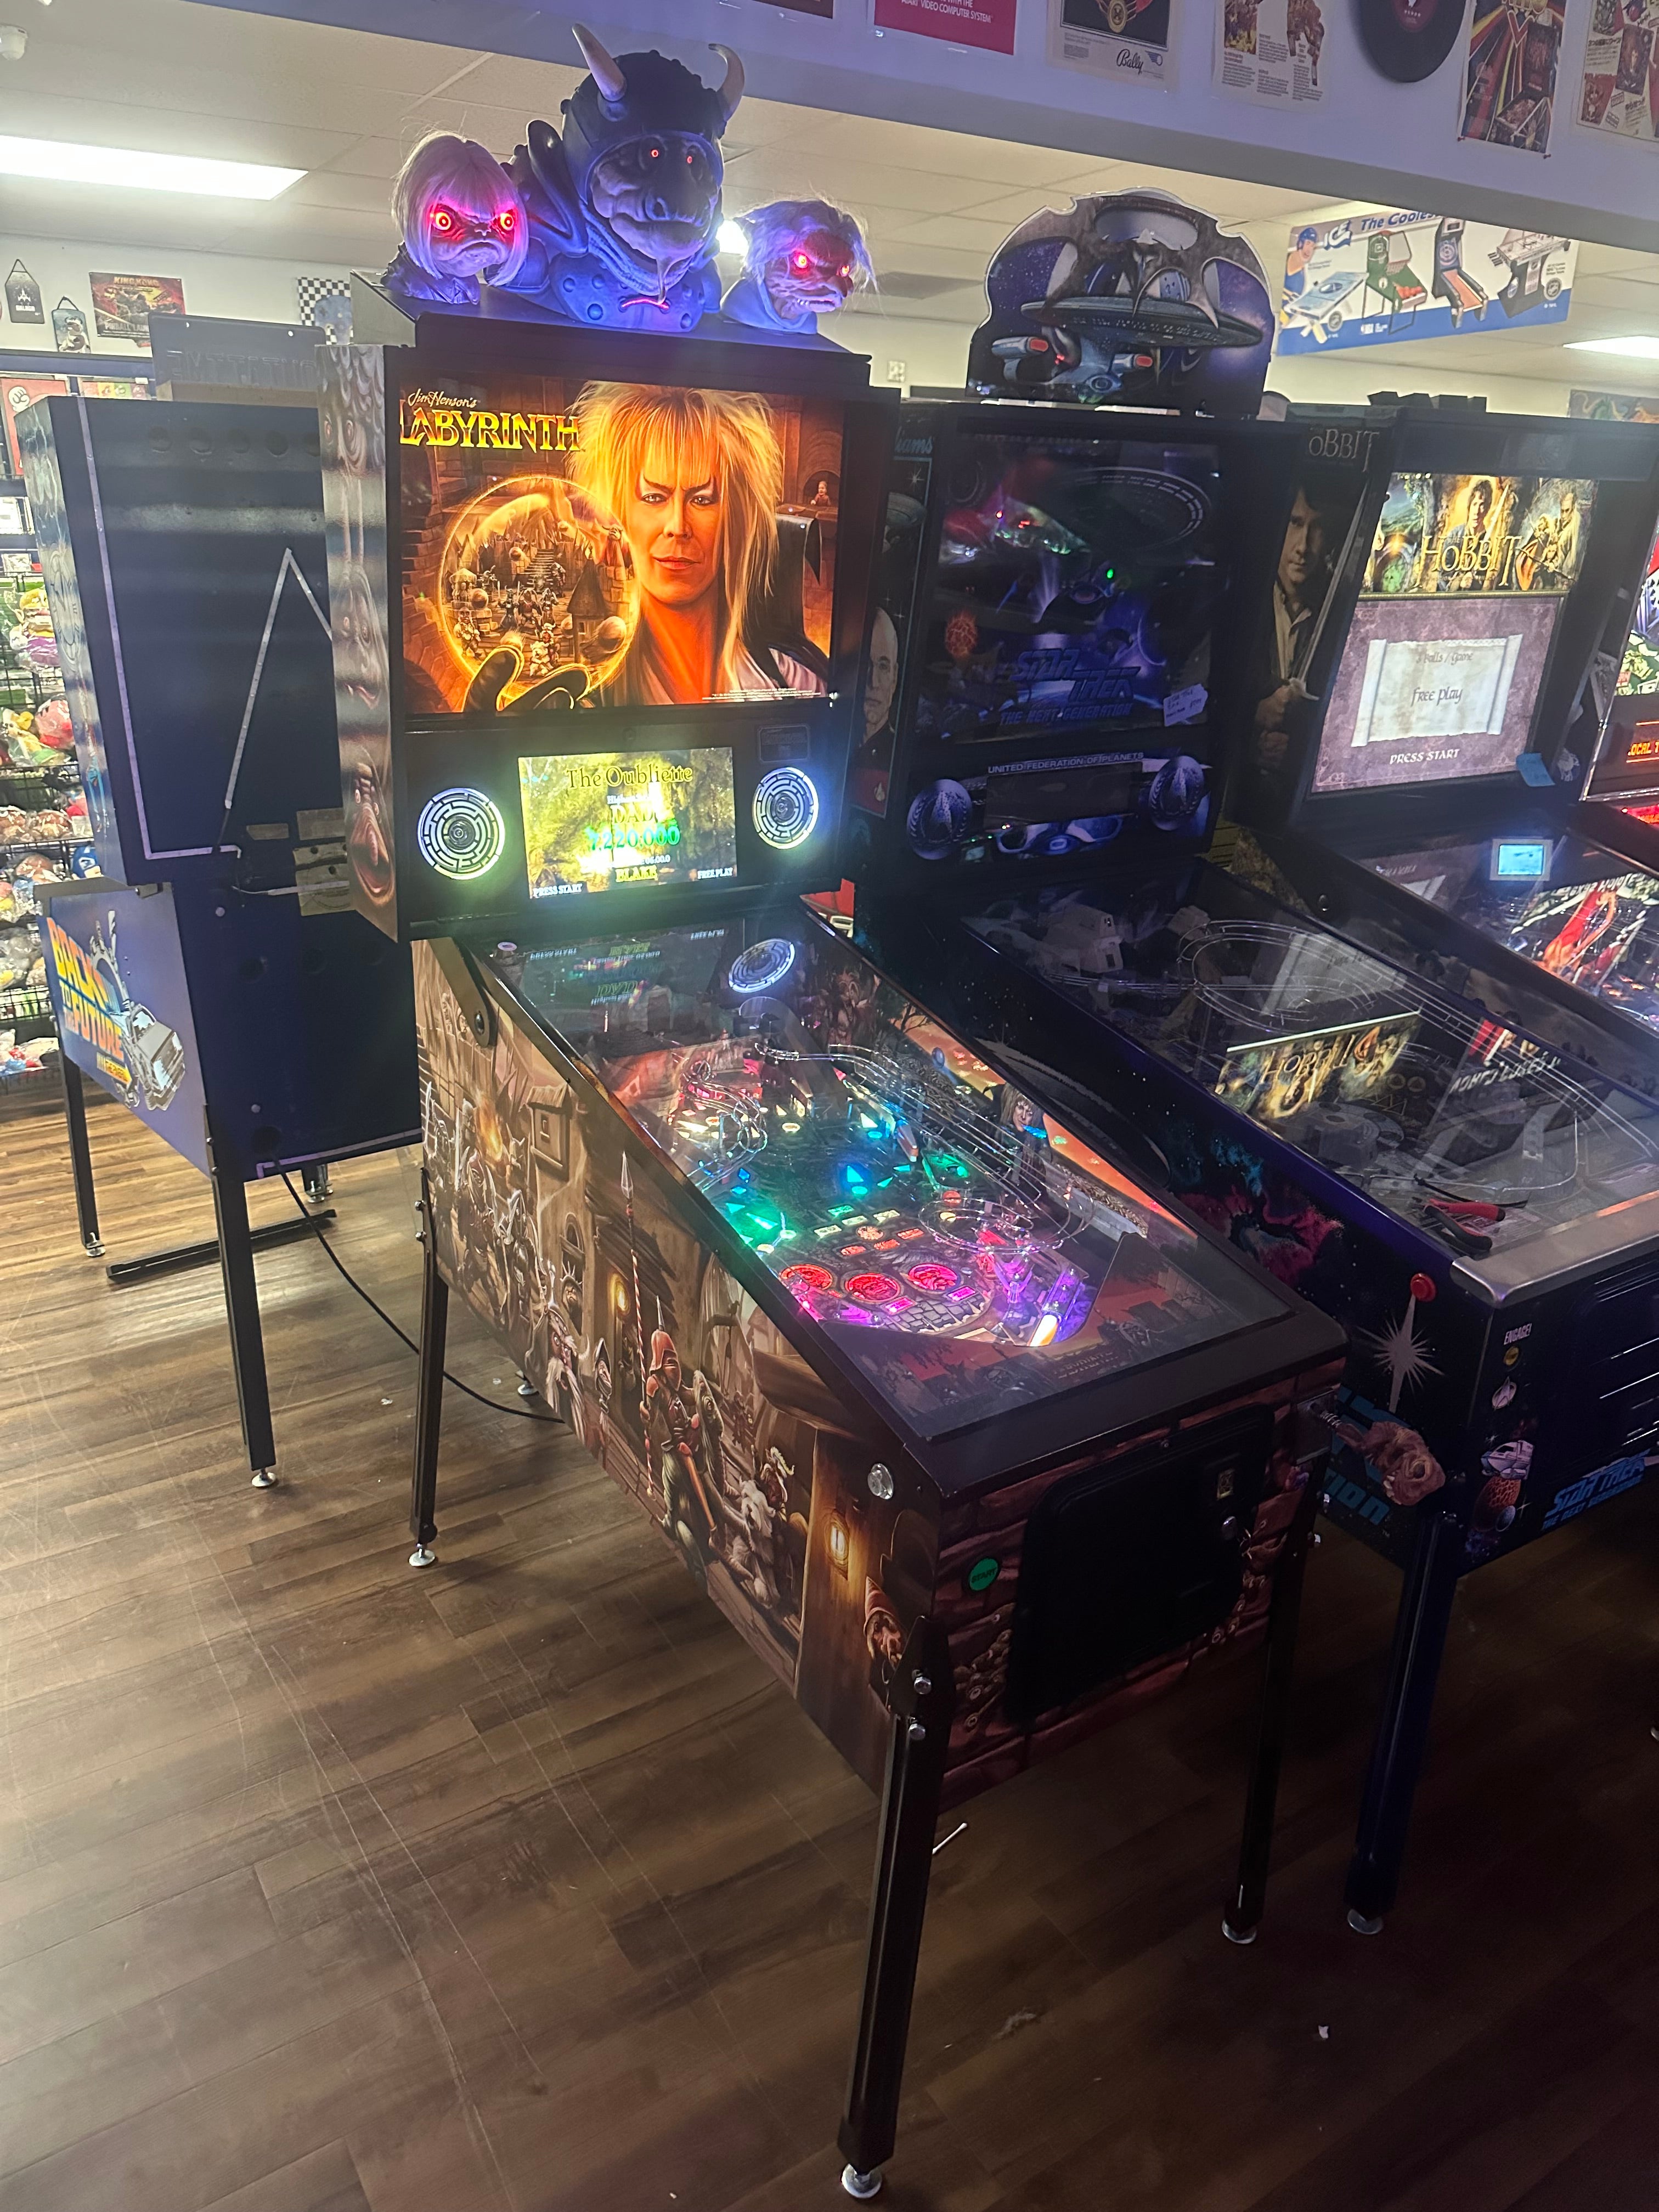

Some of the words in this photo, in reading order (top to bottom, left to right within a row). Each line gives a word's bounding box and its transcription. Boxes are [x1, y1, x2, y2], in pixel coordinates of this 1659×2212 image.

[921, 0, 939, 11] VIDEO
[939, 4, 970, 18] COMPUTER
[970, 10, 992, 23] SYSTEM
[1116, 48, 1144, 75] Bally
[1323, 220, 1352, 250] ICE
[1361, 217, 1384, 232] The
[114, 276, 136, 286] KING
[136, 278, 160, 288] KONG
[408, 388, 431, 407] Jim
[429, 391, 477, 408] Henson's
[399, 399, 580, 453] LABYRINTH
[1009, 648, 1081, 681] STAR
[1001, 711, 1023, 725] THE
[1027, 708, 1058, 724] NEXT
[1063, 704, 1133, 721] GENERATION
[988, 763, 1023, 774] UNITED
[1026, 757, 1084, 770] FEDERATION
[1086, 755, 1099, 765] OF
[1102, 752, 1144, 763] PLANETS
[1390, 752, 1424, 765] PRESS
[1426, 748, 1460, 761] START
[566, 767, 602, 789] The
[605, 763, 693, 787] Oubliette
[697, 869, 714, 879] FREE
[714, 867, 733, 878] PLAY
[533, 885, 558, 898] PRESS
[558, 883, 583, 895] START
[47, 917, 108, 1011] BACK
[59, 979, 72, 1009] TO
[70, 989, 125, 1062] FUTURE
[1504, 1323, 1532, 1345] ENGAGE!
[971, 1567, 997, 1584] START
